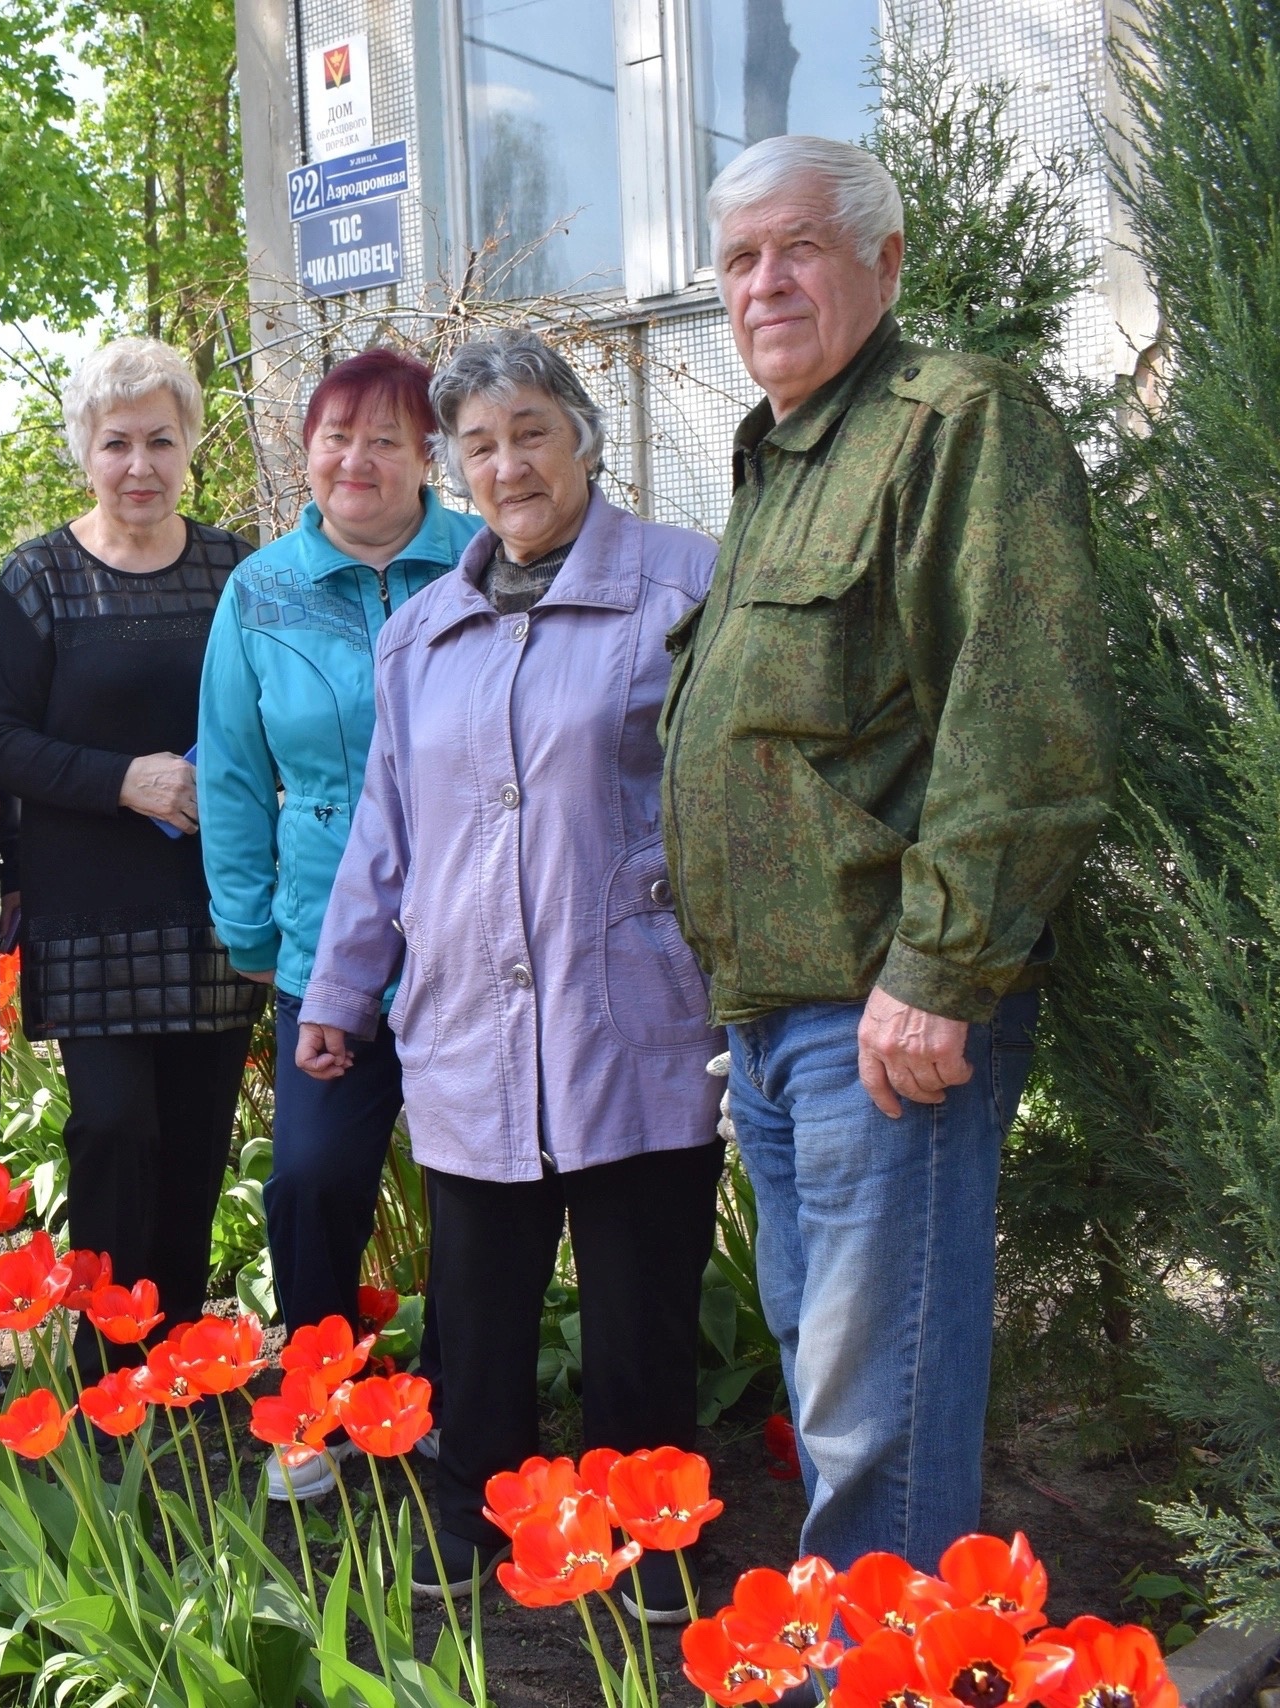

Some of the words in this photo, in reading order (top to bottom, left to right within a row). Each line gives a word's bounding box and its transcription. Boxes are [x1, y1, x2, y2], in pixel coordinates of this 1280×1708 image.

[328, 101, 353, 124] ДОМ
[316, 117, 367, 142] ОБРАЗЦОВОГО
[325, 134, 360, 152] ПОРЯДКА
[350, 153, 378, 167] УЛИЦА
[291, 169, 320, 215] 22
[326, 170, 406, 201] Аэродромная
[329, 213, 363, 246] ТОС
[303, 242, 399, 286] «ЧКАЛОВЕЦ»
